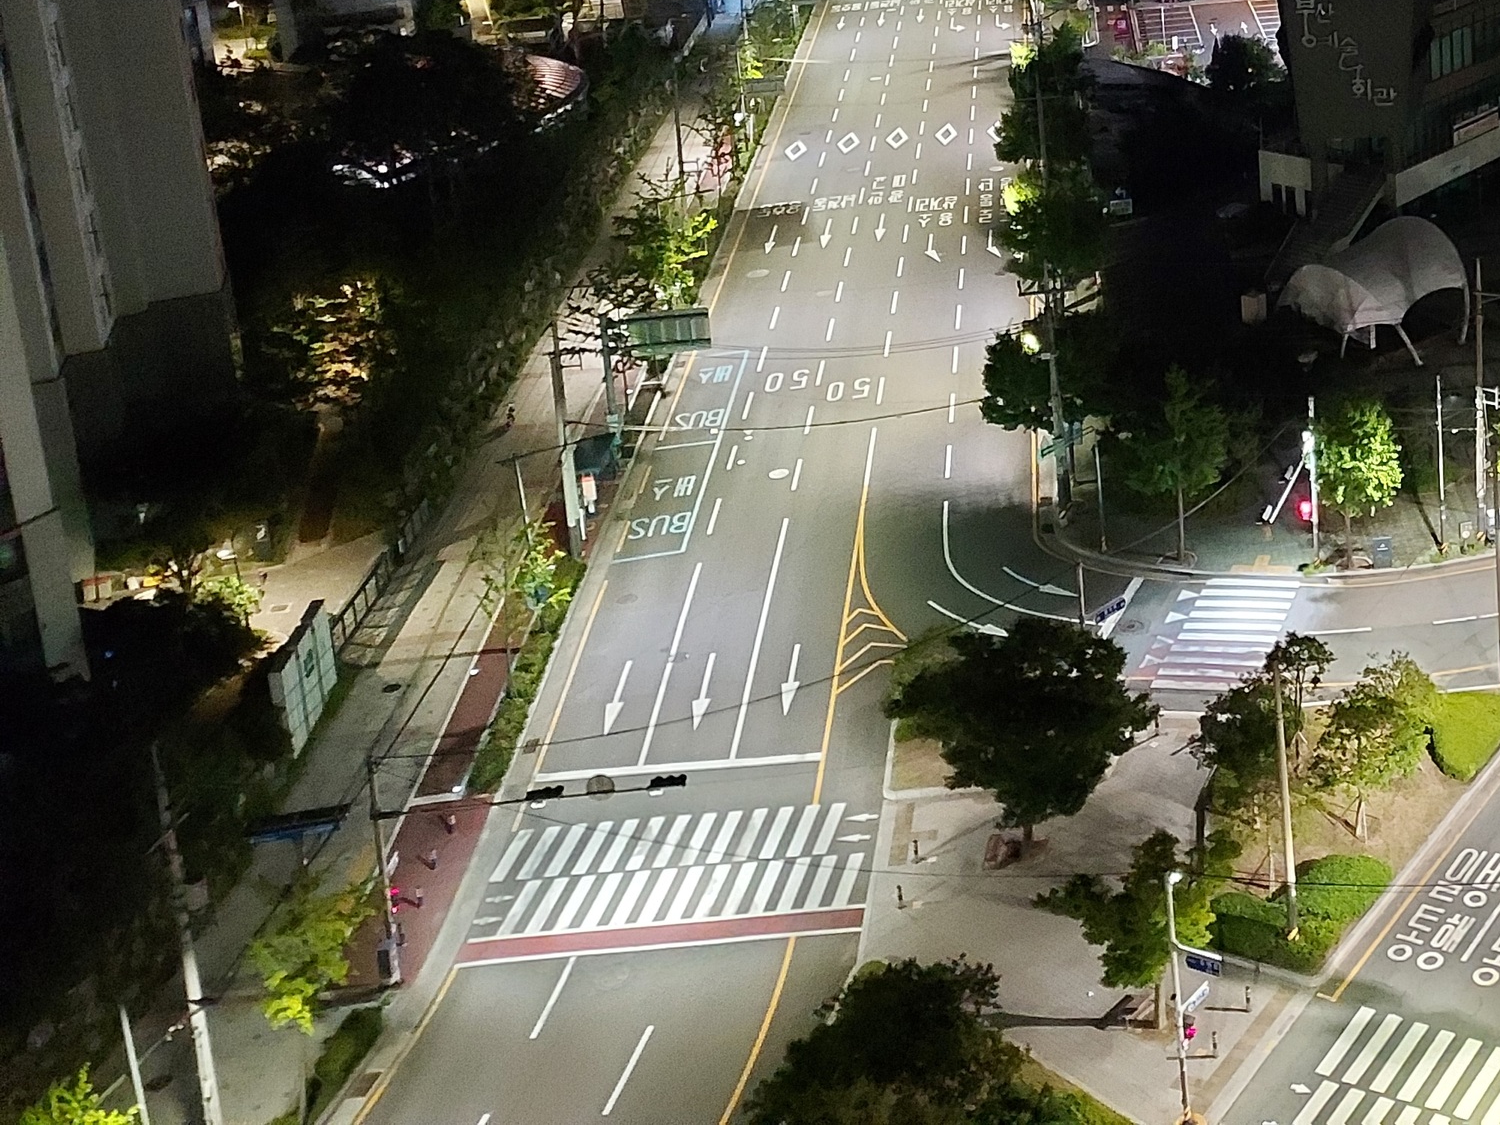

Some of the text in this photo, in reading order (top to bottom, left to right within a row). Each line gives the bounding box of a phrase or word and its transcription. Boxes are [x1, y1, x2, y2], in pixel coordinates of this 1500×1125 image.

[1301, 31, 1364, 71] 예술
[1352, 76, 1398, 106] 회관
[915, 195, 958, 213] 삼거리
[917, 211, 953, 228] 용소
[699, 364, 733, 385] 버스
[763, 368, 811, 393] 50
[827, 377, 871, 403] 50
[675, 408, 725, 430] BUS
[653, 474, 697, 502] 버스
[628, 511, 691, 541] BUS
[1386, 903, 1476, 972] 통행
